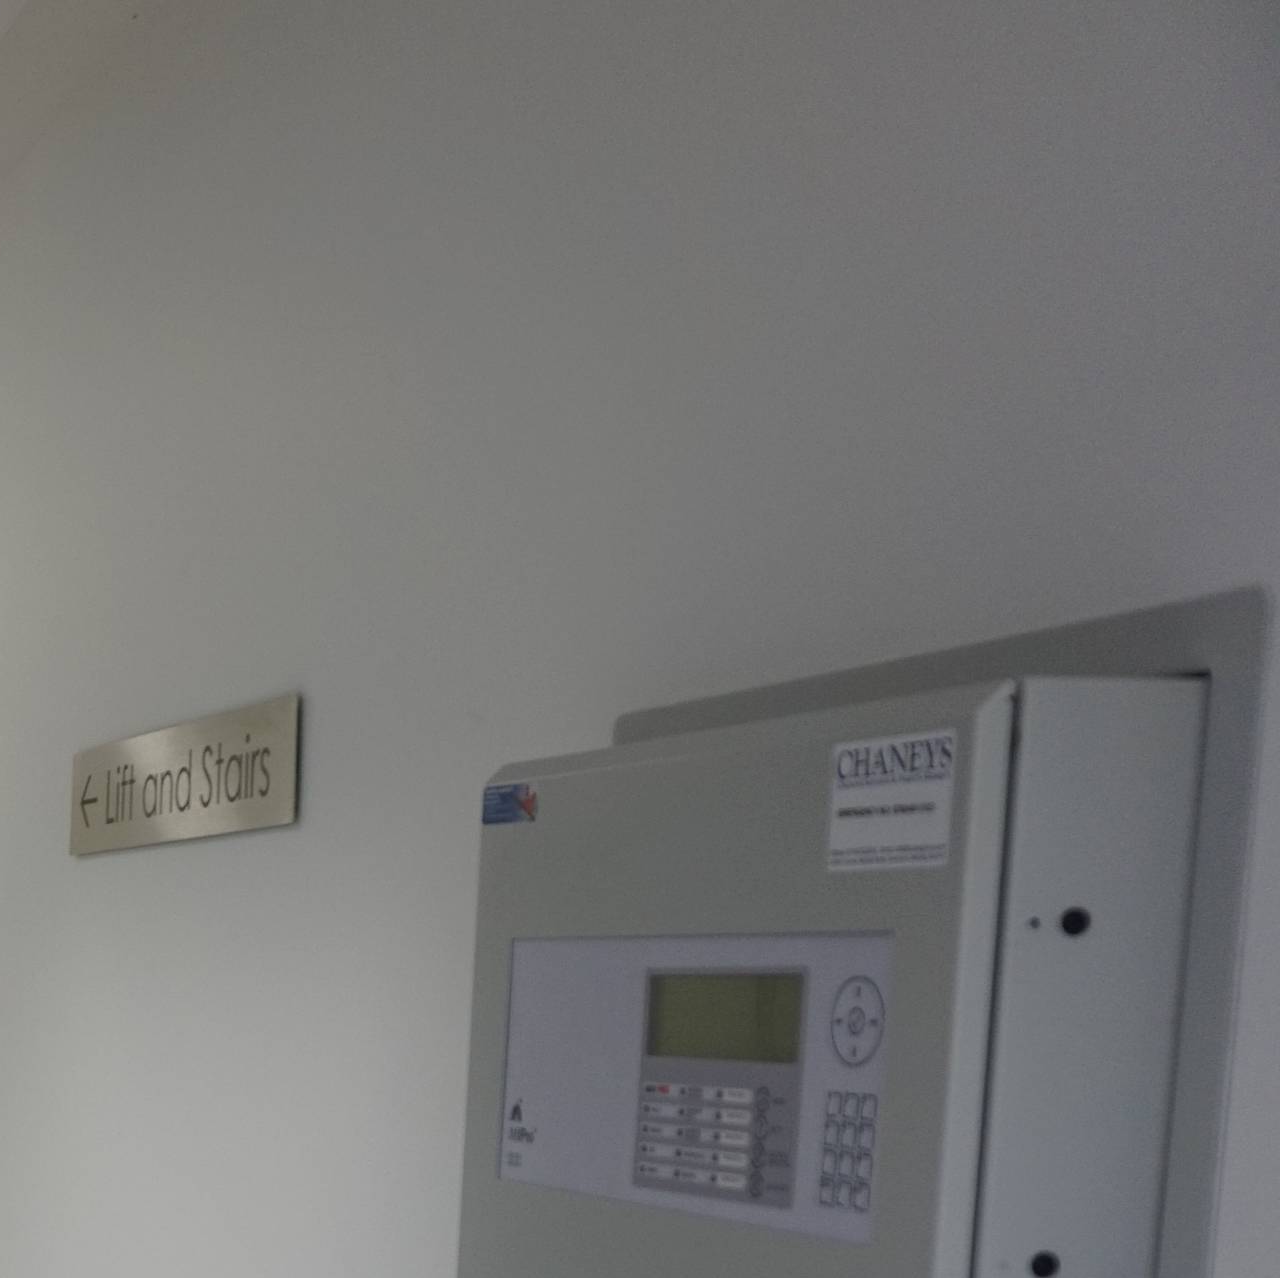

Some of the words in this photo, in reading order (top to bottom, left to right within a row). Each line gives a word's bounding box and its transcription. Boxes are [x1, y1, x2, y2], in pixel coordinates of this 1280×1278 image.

[106, 764, 136, 824] Lift
[143, 748, 193, 818] and
[200, 733, 271, 808] Stairs
[837, 736, 953, 779] CHANEYS
